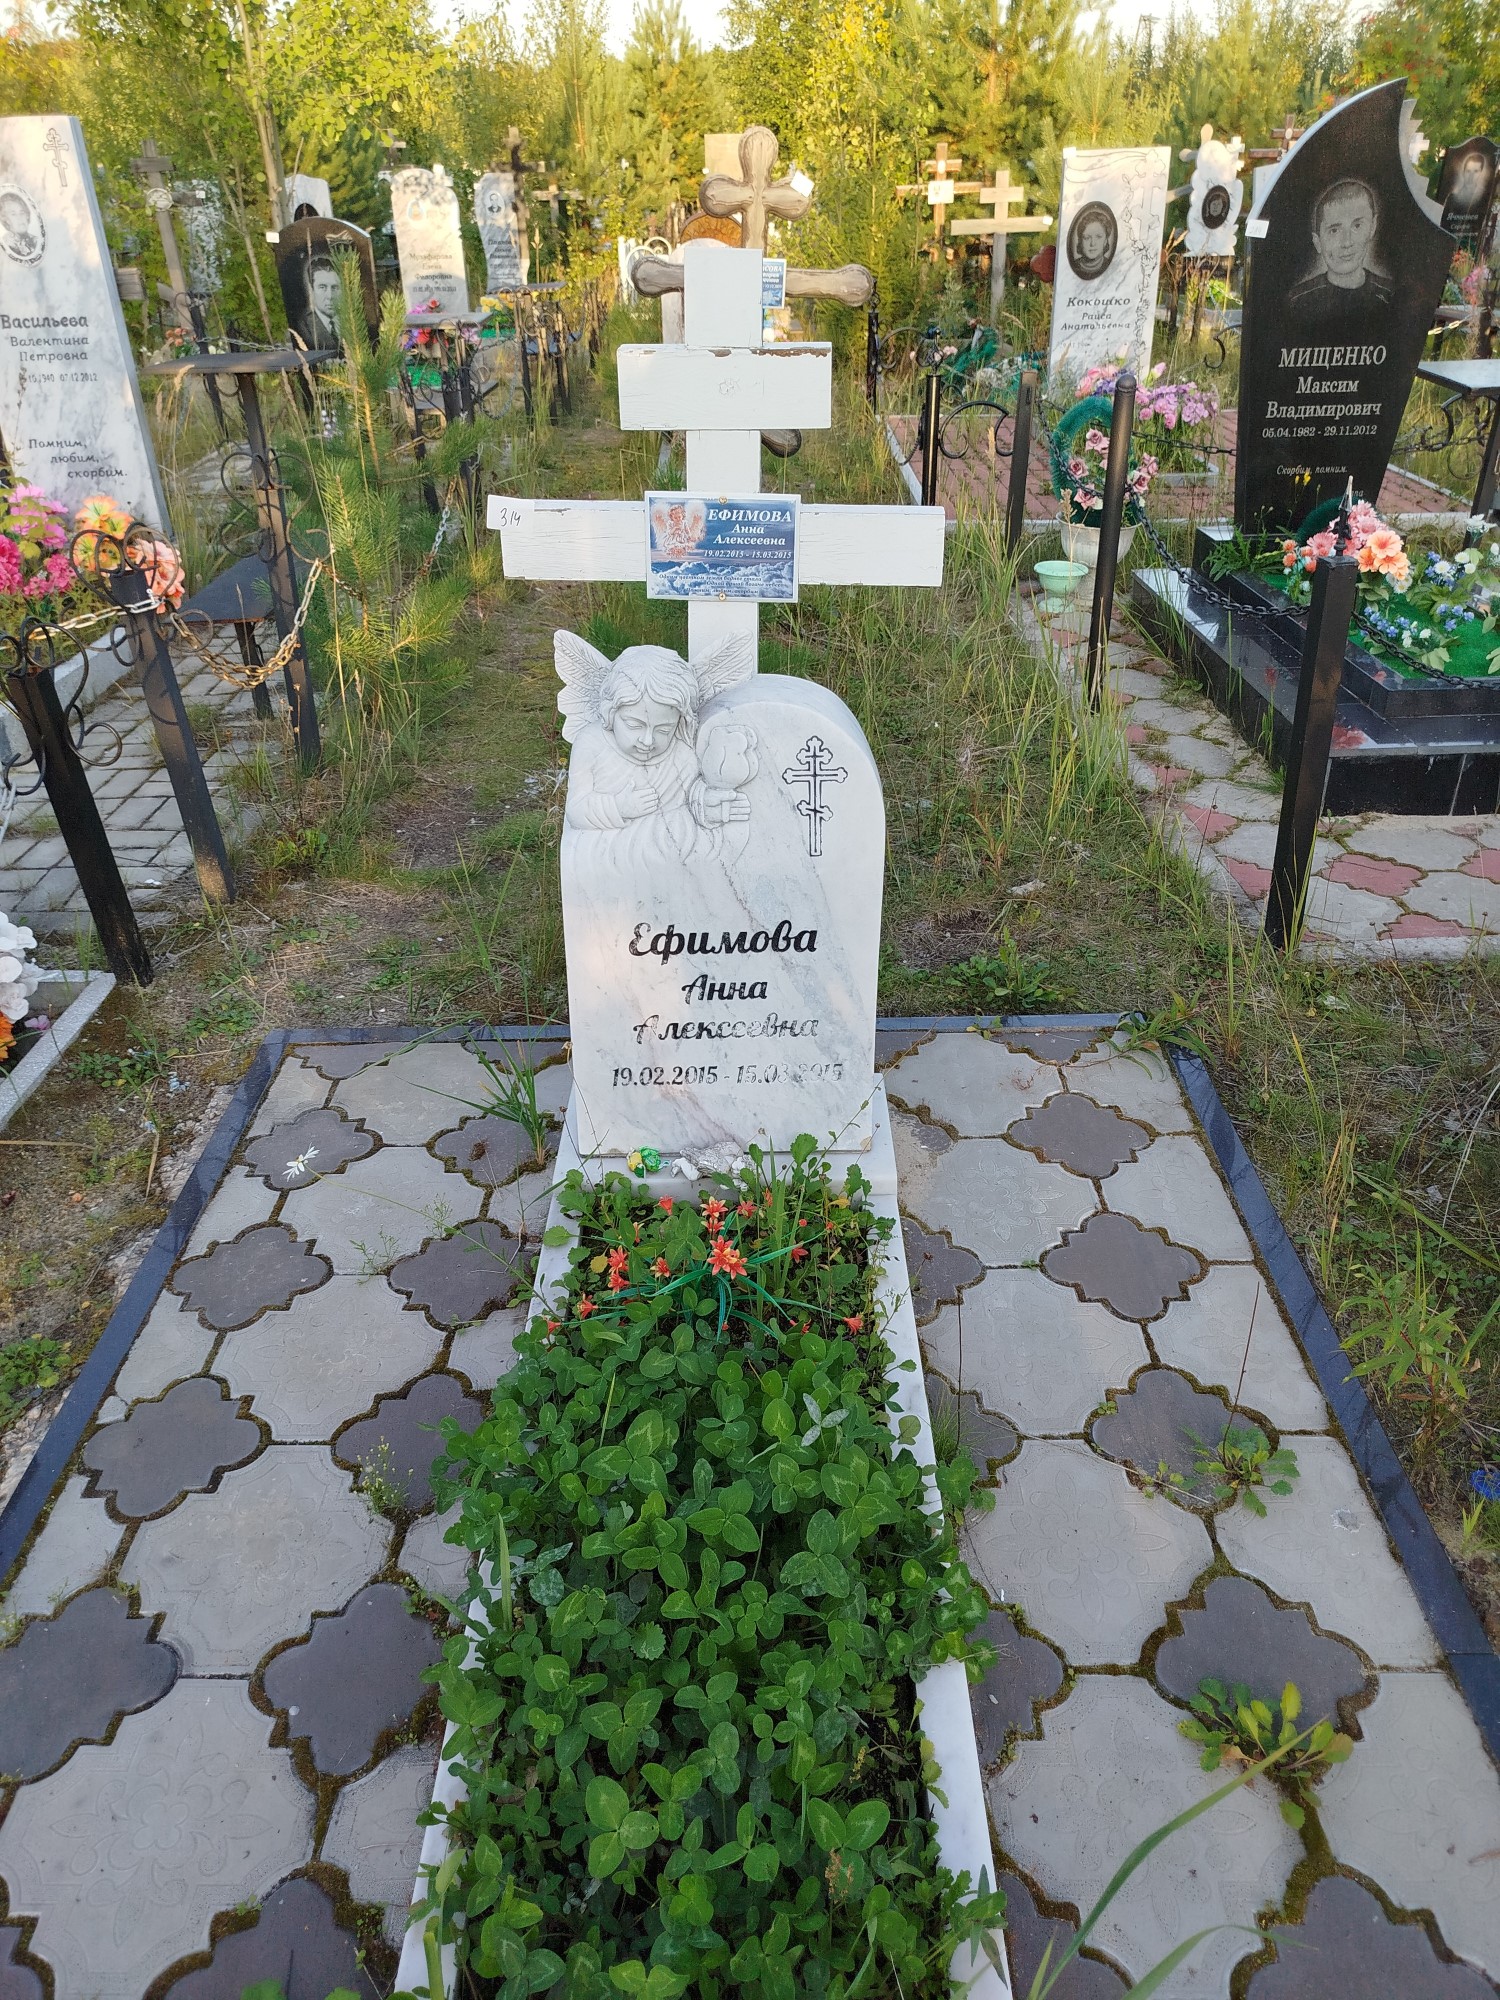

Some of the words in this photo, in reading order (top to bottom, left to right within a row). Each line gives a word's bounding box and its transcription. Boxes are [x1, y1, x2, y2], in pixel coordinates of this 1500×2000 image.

[0, 314, 89, 329] Васильева
[10, 336, 90, 347] Валентина
[19, 352, 88, 363] Петровна
[1278, 345, 1387, 371] МИЩЕНКО
[1296, 376, 1360, 394] Максим
[1266, 401, 1382, 420] Владимирович
[1262, 427, 1316, 438] 05.04.1982
[1323, 424, 1378, 437] 29.11.2012
[29, 438, 87, 449] Помним,
[51, 454, 100, 464] любим,
[67, 467, 128, 479] скорбим.
[500, 507, 521, 527] 314
[707, 508, 792, 523] ЕФИМОВА
[731, 523, 765, 534] Анна
[713, 534, 786, 546] Алексеевна
[703, 549, 744, 559] 19.02.2015
[751, 550, 792, 560] 15.03.2015
[628, 919, 818, 965] Ефимова
[681, 974, 768, 1004] Анна
[633, 1012, 819, 1044] Алексеевна
[612, 1066, 718, 1088] 19.02.2015
